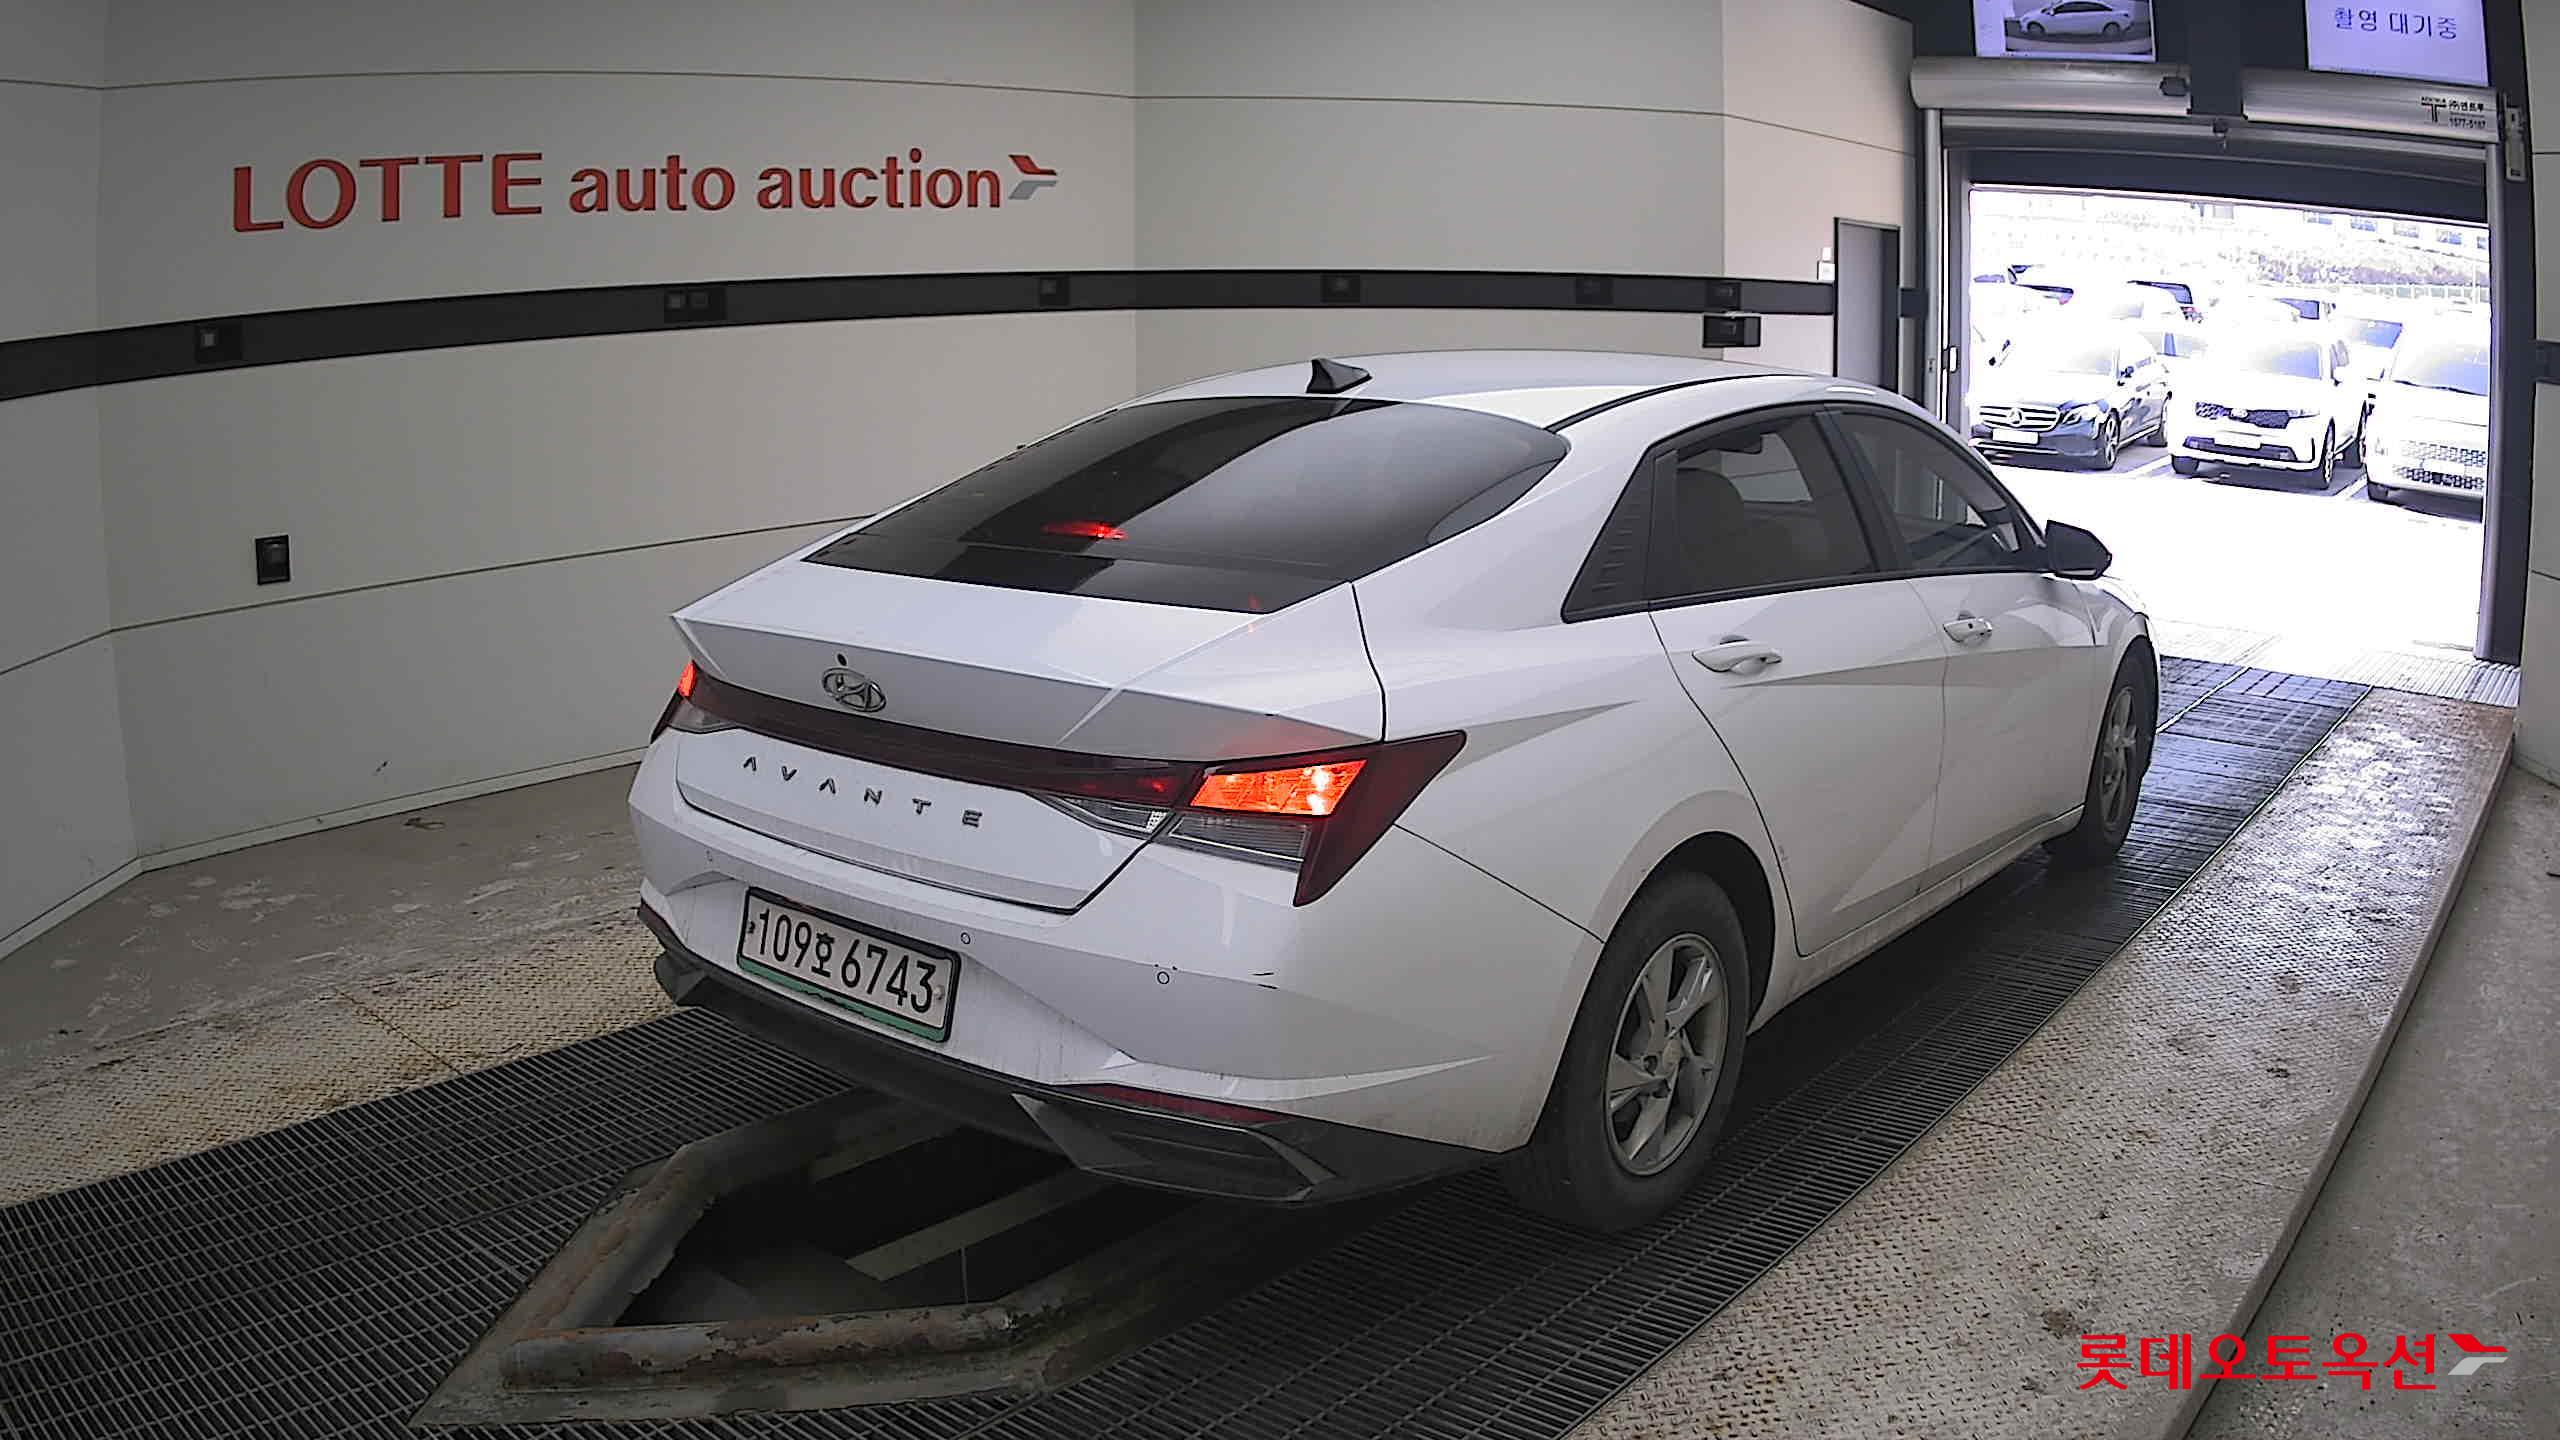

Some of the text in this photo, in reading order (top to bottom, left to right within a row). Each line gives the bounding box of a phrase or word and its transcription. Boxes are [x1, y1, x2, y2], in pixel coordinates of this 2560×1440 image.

[2335, 7, 2457, 40] 촬영 대기중
[233, 147, 1002, 233] LOTTE auto auction
[743, 756, 983, 828] AVANTE
